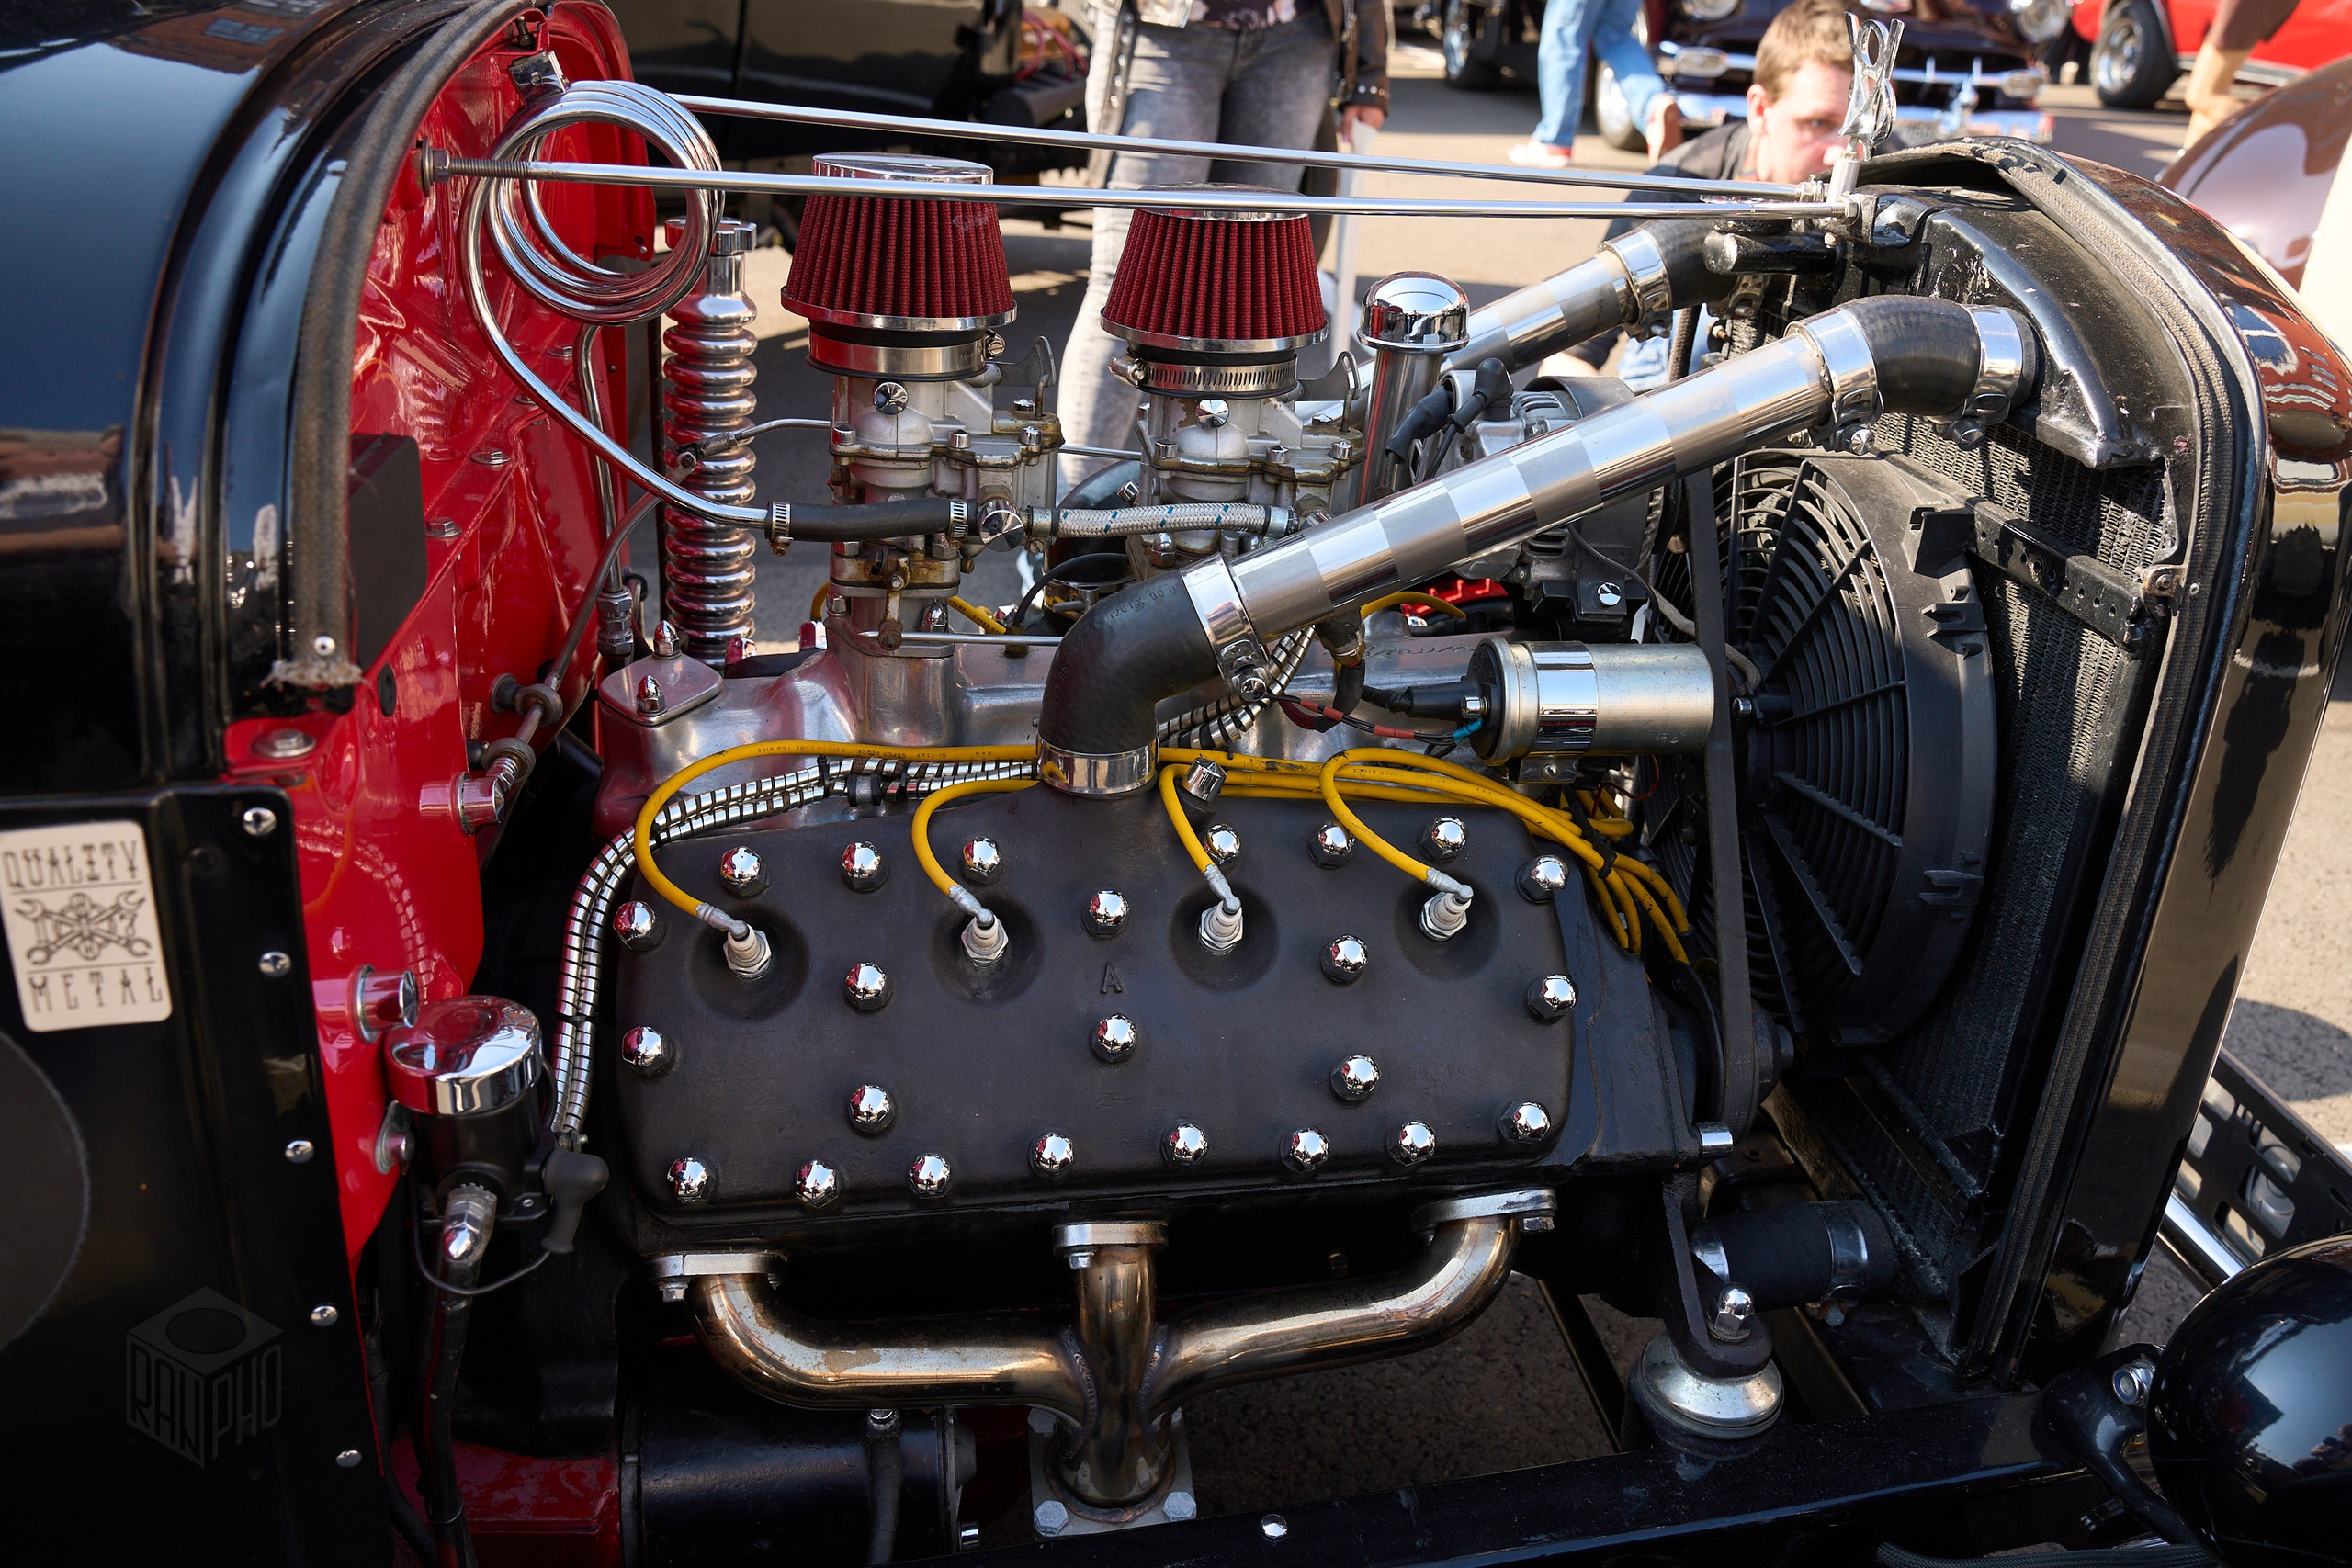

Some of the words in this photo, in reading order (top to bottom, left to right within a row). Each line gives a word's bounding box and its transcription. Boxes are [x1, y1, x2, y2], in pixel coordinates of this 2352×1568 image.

[2, 840, 138, 889] QUALITY
[28, 967, 164, 1013] METAL
[1100, 962, 1124, 994] A
